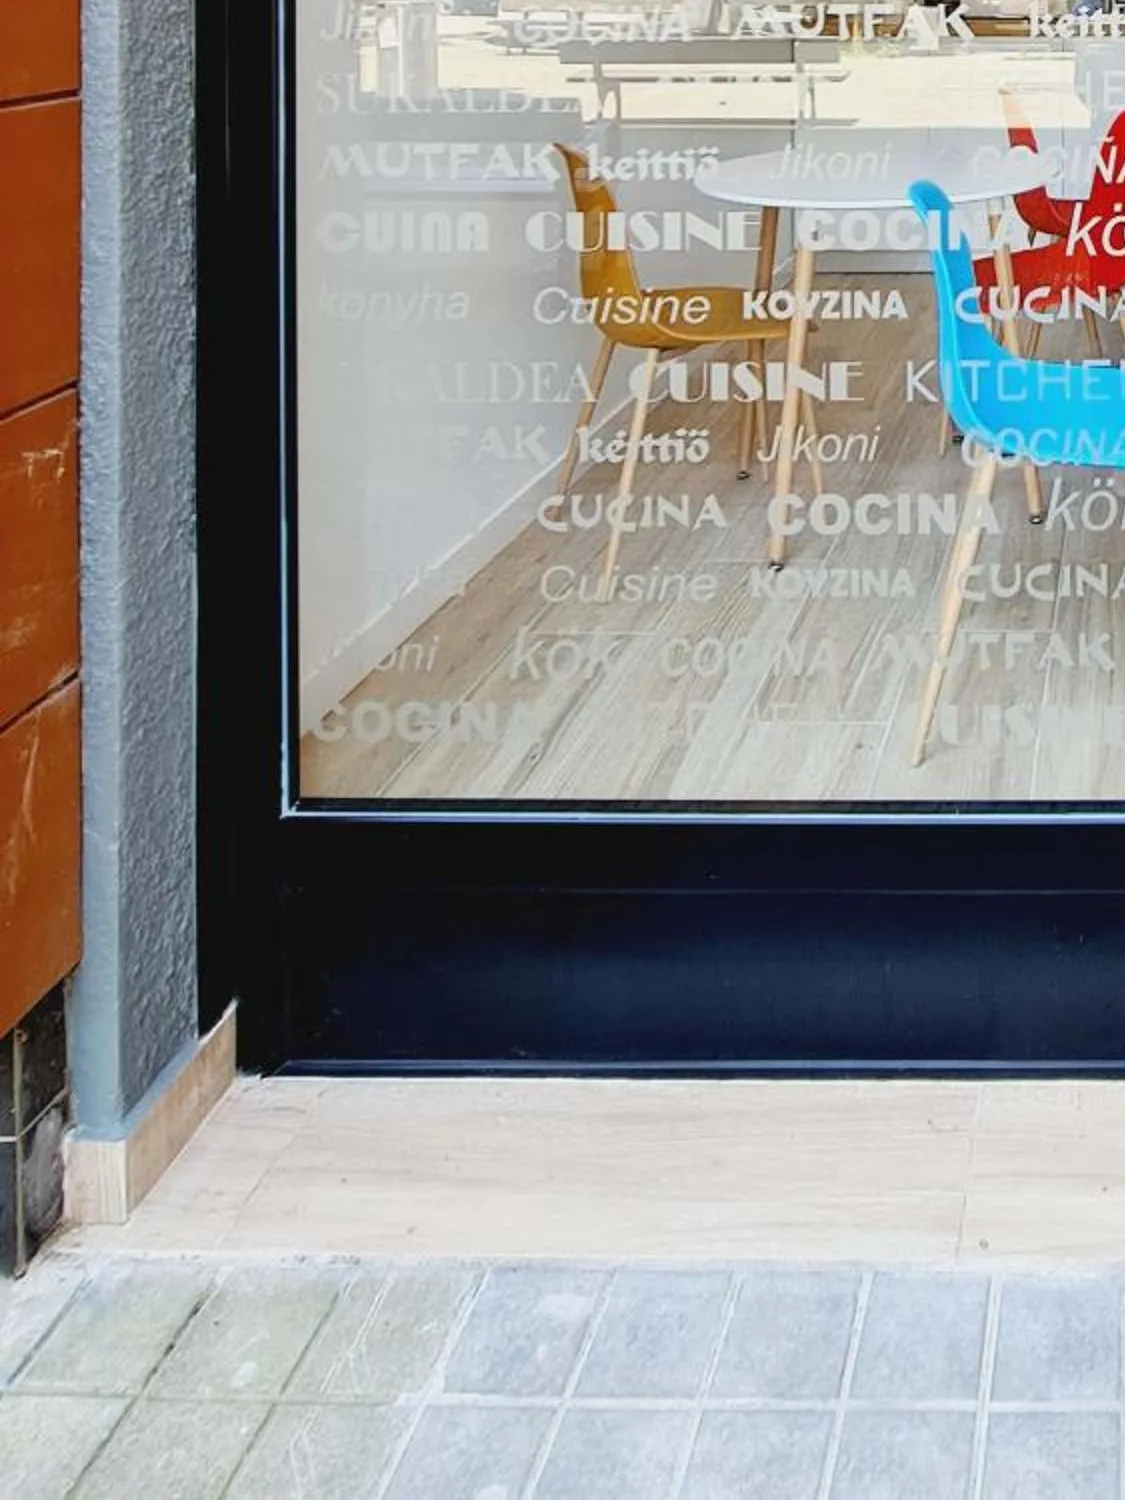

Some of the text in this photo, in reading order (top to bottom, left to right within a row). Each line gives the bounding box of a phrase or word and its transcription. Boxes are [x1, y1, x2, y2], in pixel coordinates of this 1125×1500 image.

[321, 142, 563, 182] MUTFAK
[586, 146, 720, 183] keittiö
[769, 142, 893, 182] Jikoni
[317, 210, 491, 253] CUINA
[525, 210, 761, 252] CUISINE
[798, 209, 1032, 252] COCINA
[532, 286, 710, 325] Cuisine
[742, 291, 909, 320] KOYZINA
[628, 360, 865, 402] CUISINE
[536, 494, 728, 533] CUCINA
[767, 492, 1001, 535] COCINA
[540, 565, 718, 603] Cuisine
